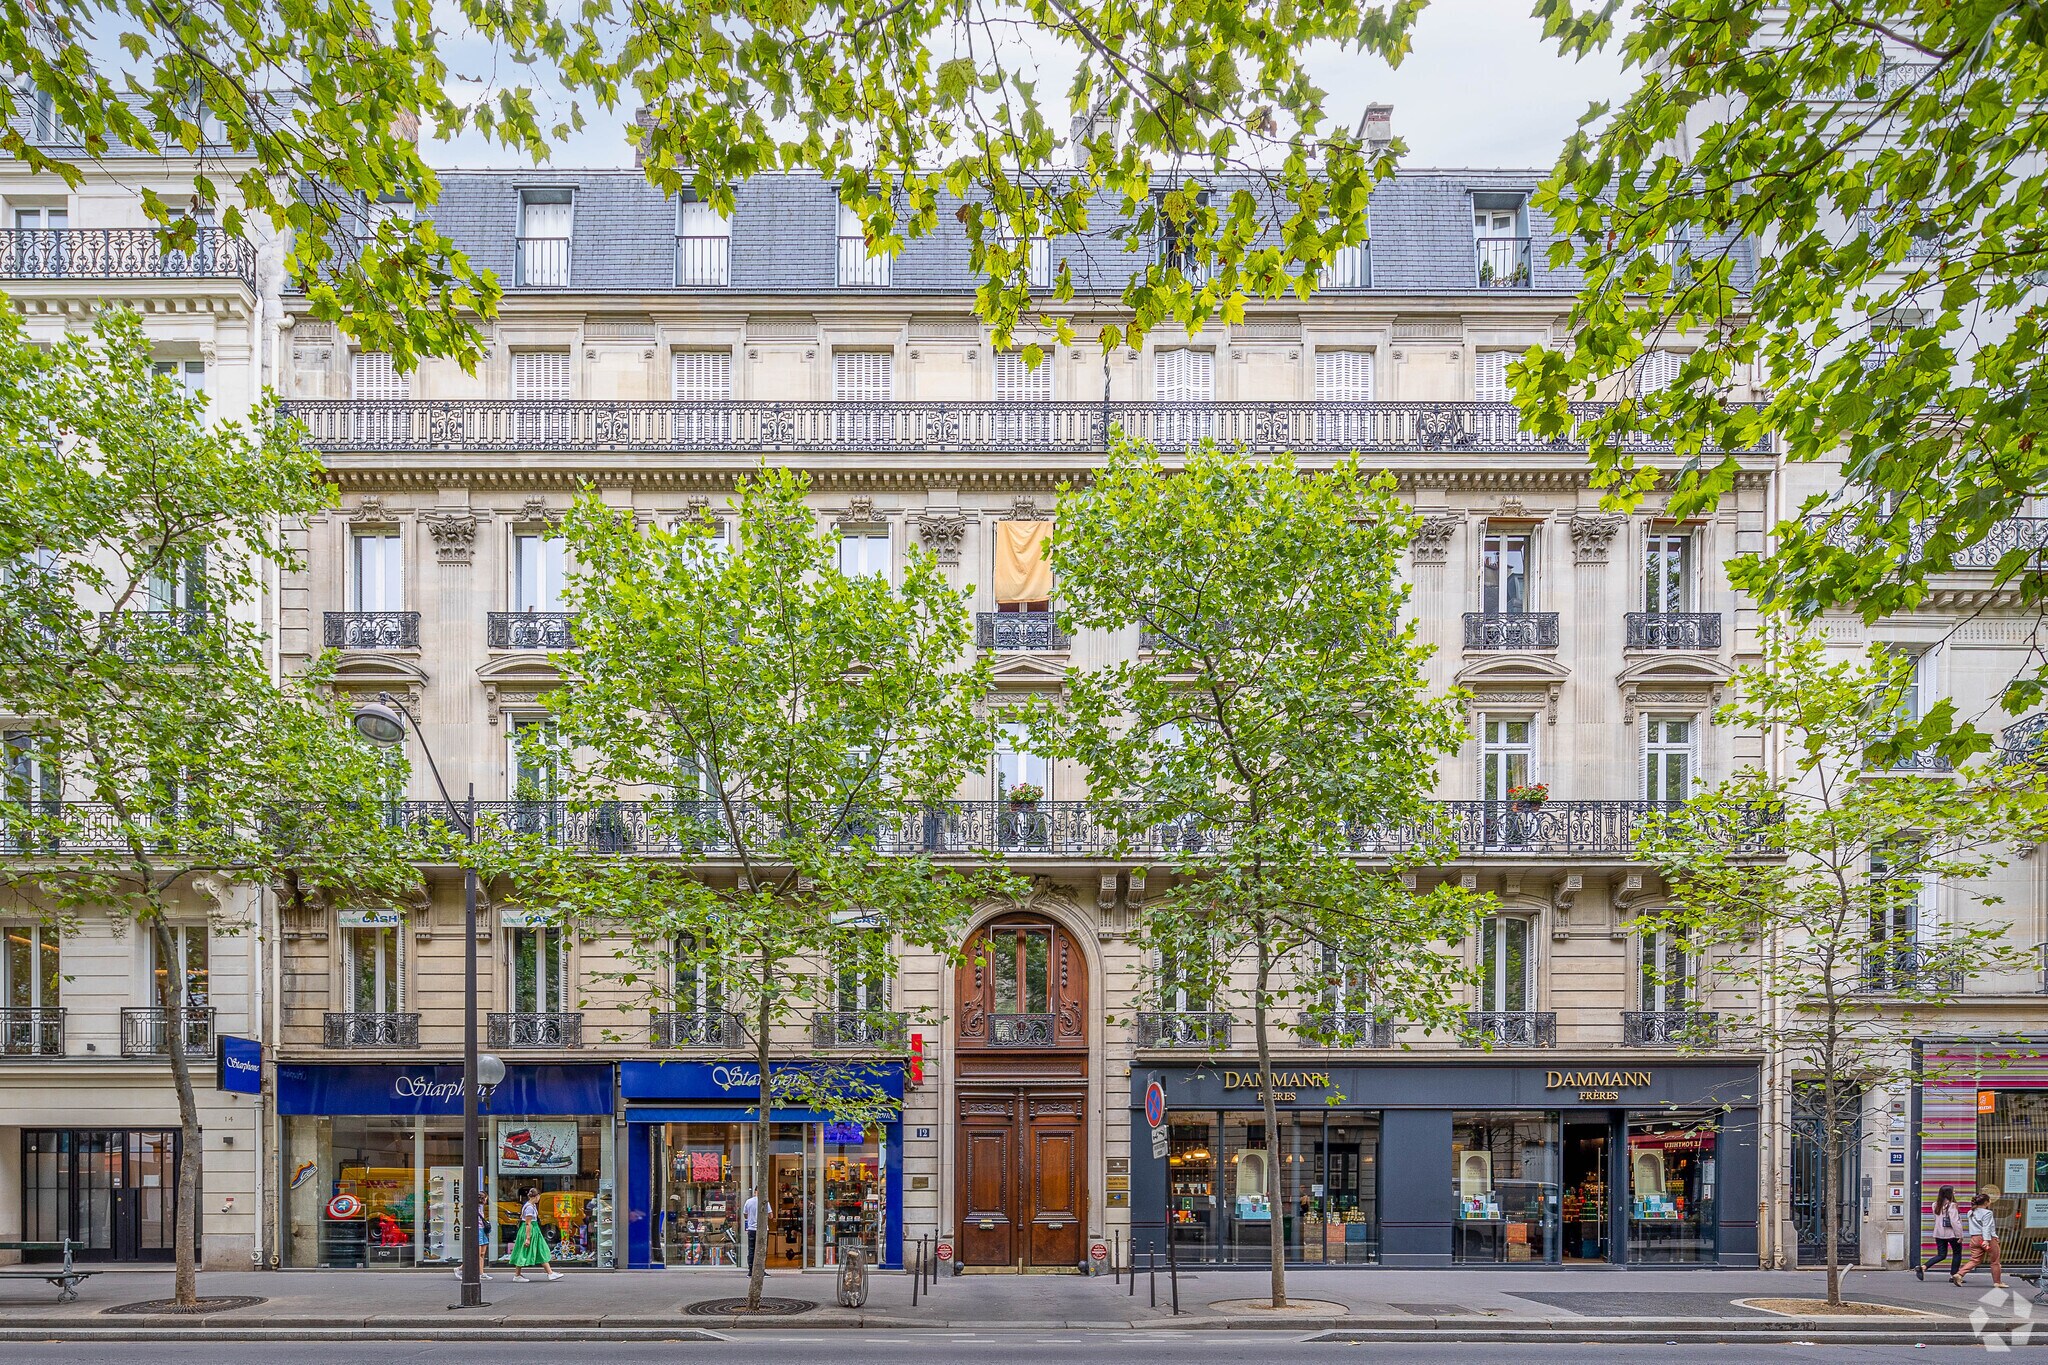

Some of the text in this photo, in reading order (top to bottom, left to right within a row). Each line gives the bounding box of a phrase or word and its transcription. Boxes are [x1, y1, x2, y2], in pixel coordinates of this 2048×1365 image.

[226, 1057, 260, 1073] Starphone
[1545, 1071, 1652, 1088] DAMMANN
[1257, 1090, 1297, 1101] FÈRES
[1579, 1089, 1619, 1100] FRÈRES
[919, 1128, 928, 1137] 12
[453, 1179, 461, 1241] HERITAGE
